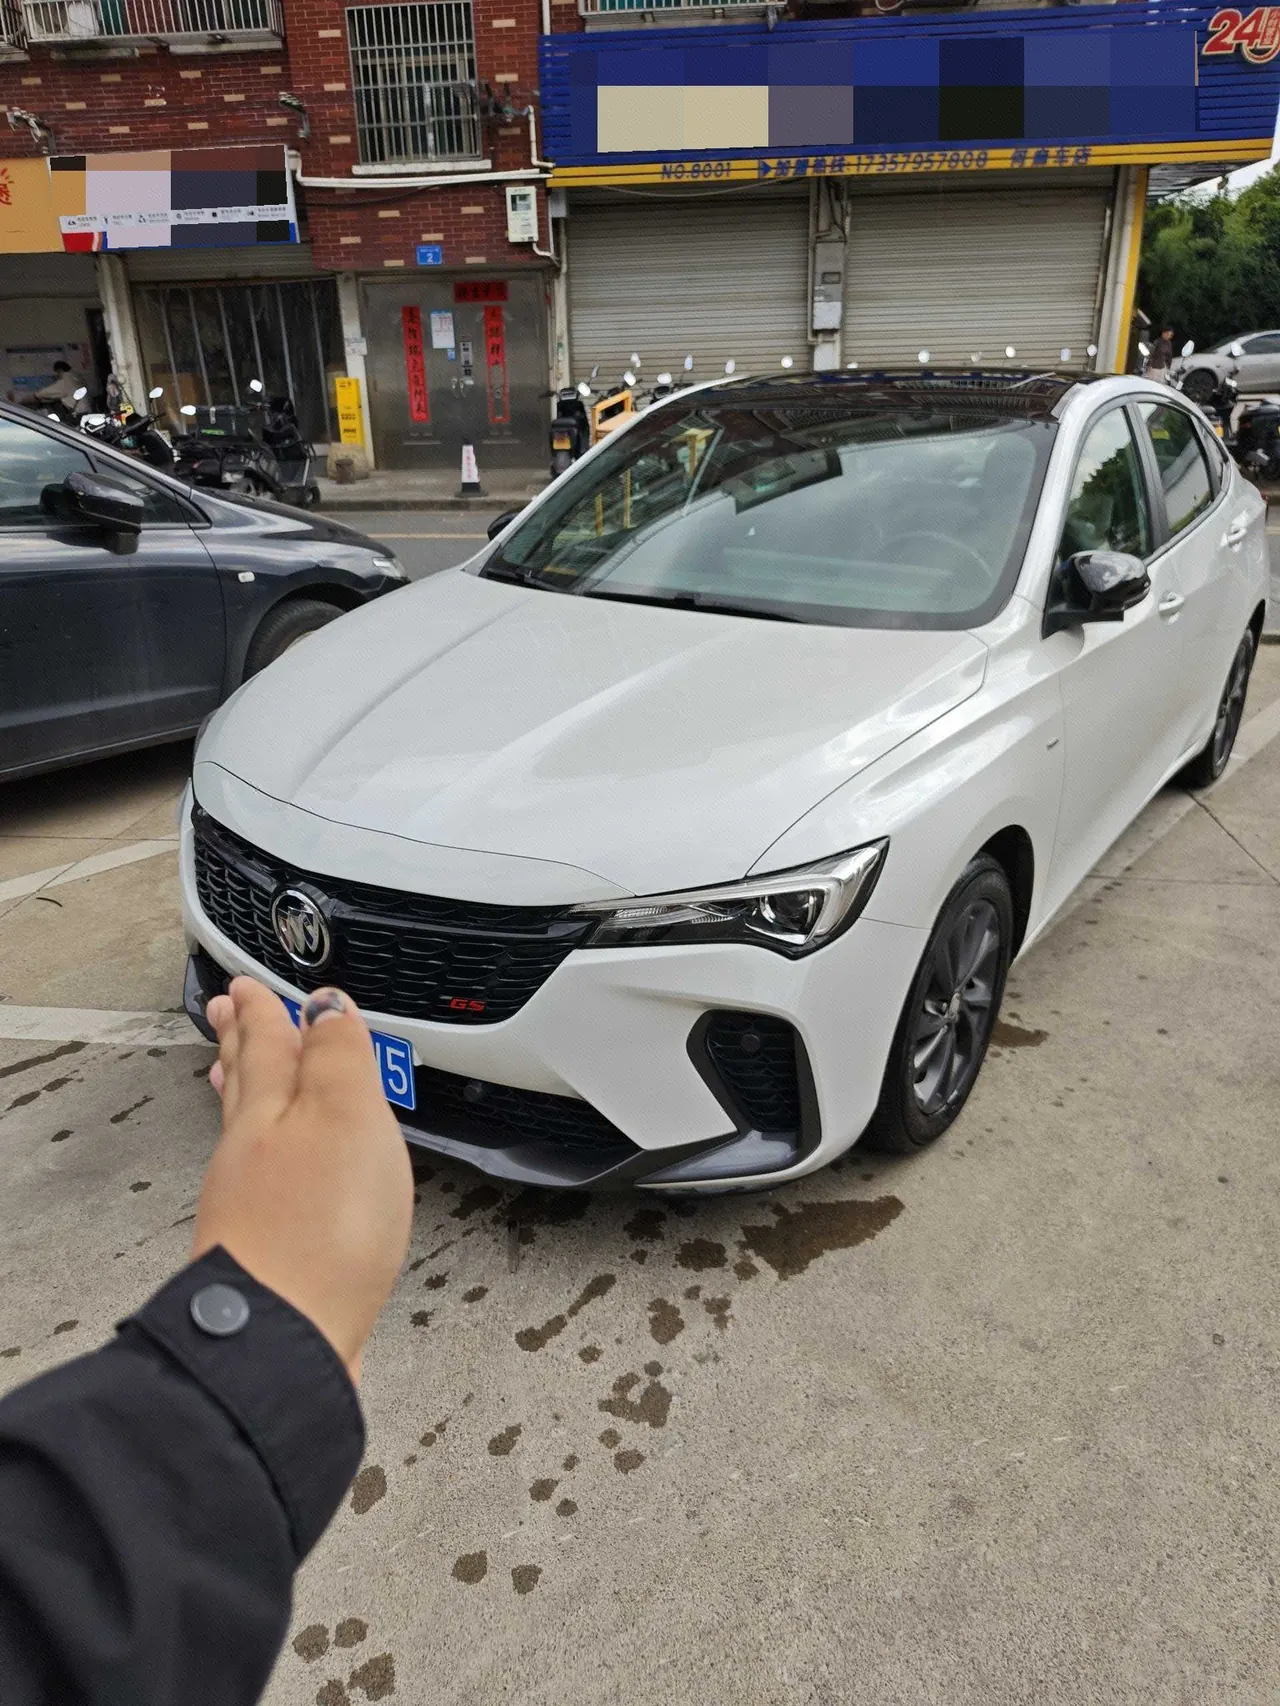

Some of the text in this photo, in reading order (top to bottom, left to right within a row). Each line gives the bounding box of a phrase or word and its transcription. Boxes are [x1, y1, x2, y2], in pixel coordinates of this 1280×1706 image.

[1202, 8, 1264, 55] 24
[661, 162, 731, 179] NO.8001
[450, 997, 486, 1011] GS
